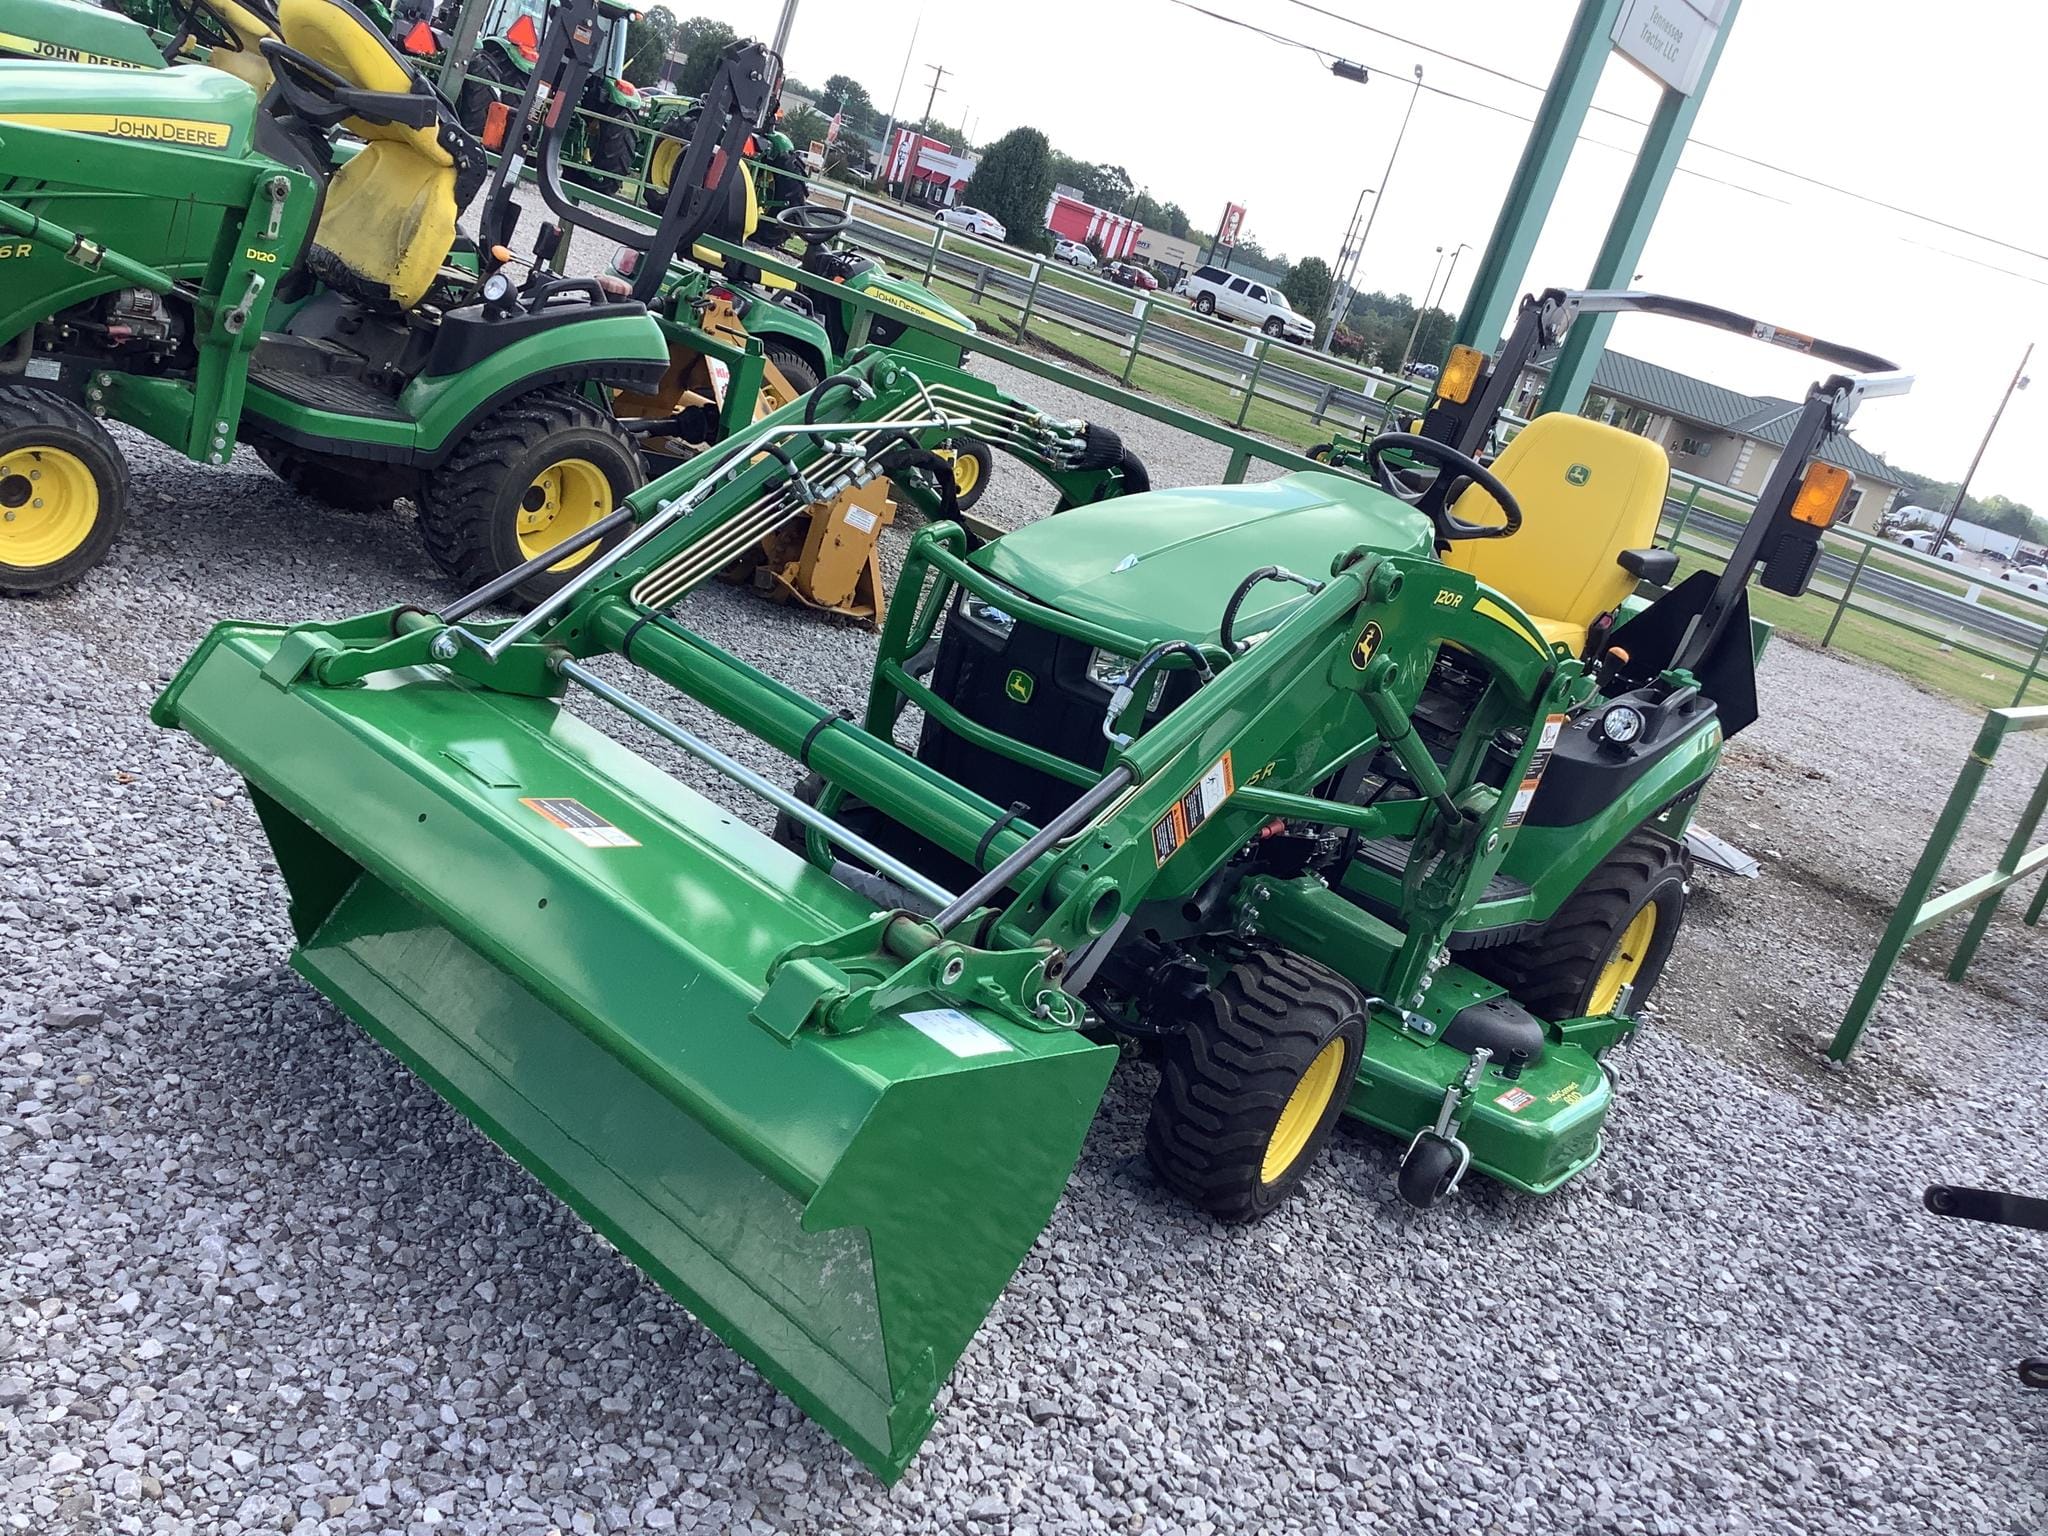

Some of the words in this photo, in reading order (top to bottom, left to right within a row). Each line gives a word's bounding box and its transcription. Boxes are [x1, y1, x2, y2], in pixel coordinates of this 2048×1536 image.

[1650, 5, 1683, 43] Tennessee
[33, 41, 80, 62] JOHN
[87, 54, 141, 69] DEE
[1640, 22, 1664, 52] Tractor
[1663, 41, 1680, 62] LLC
[108, 118, 157, 137] JOHN
[162, 123, 217, 144] DEERE
[246, 248, 277, 263] D120
[873, 290, 898, 306] JOHN
